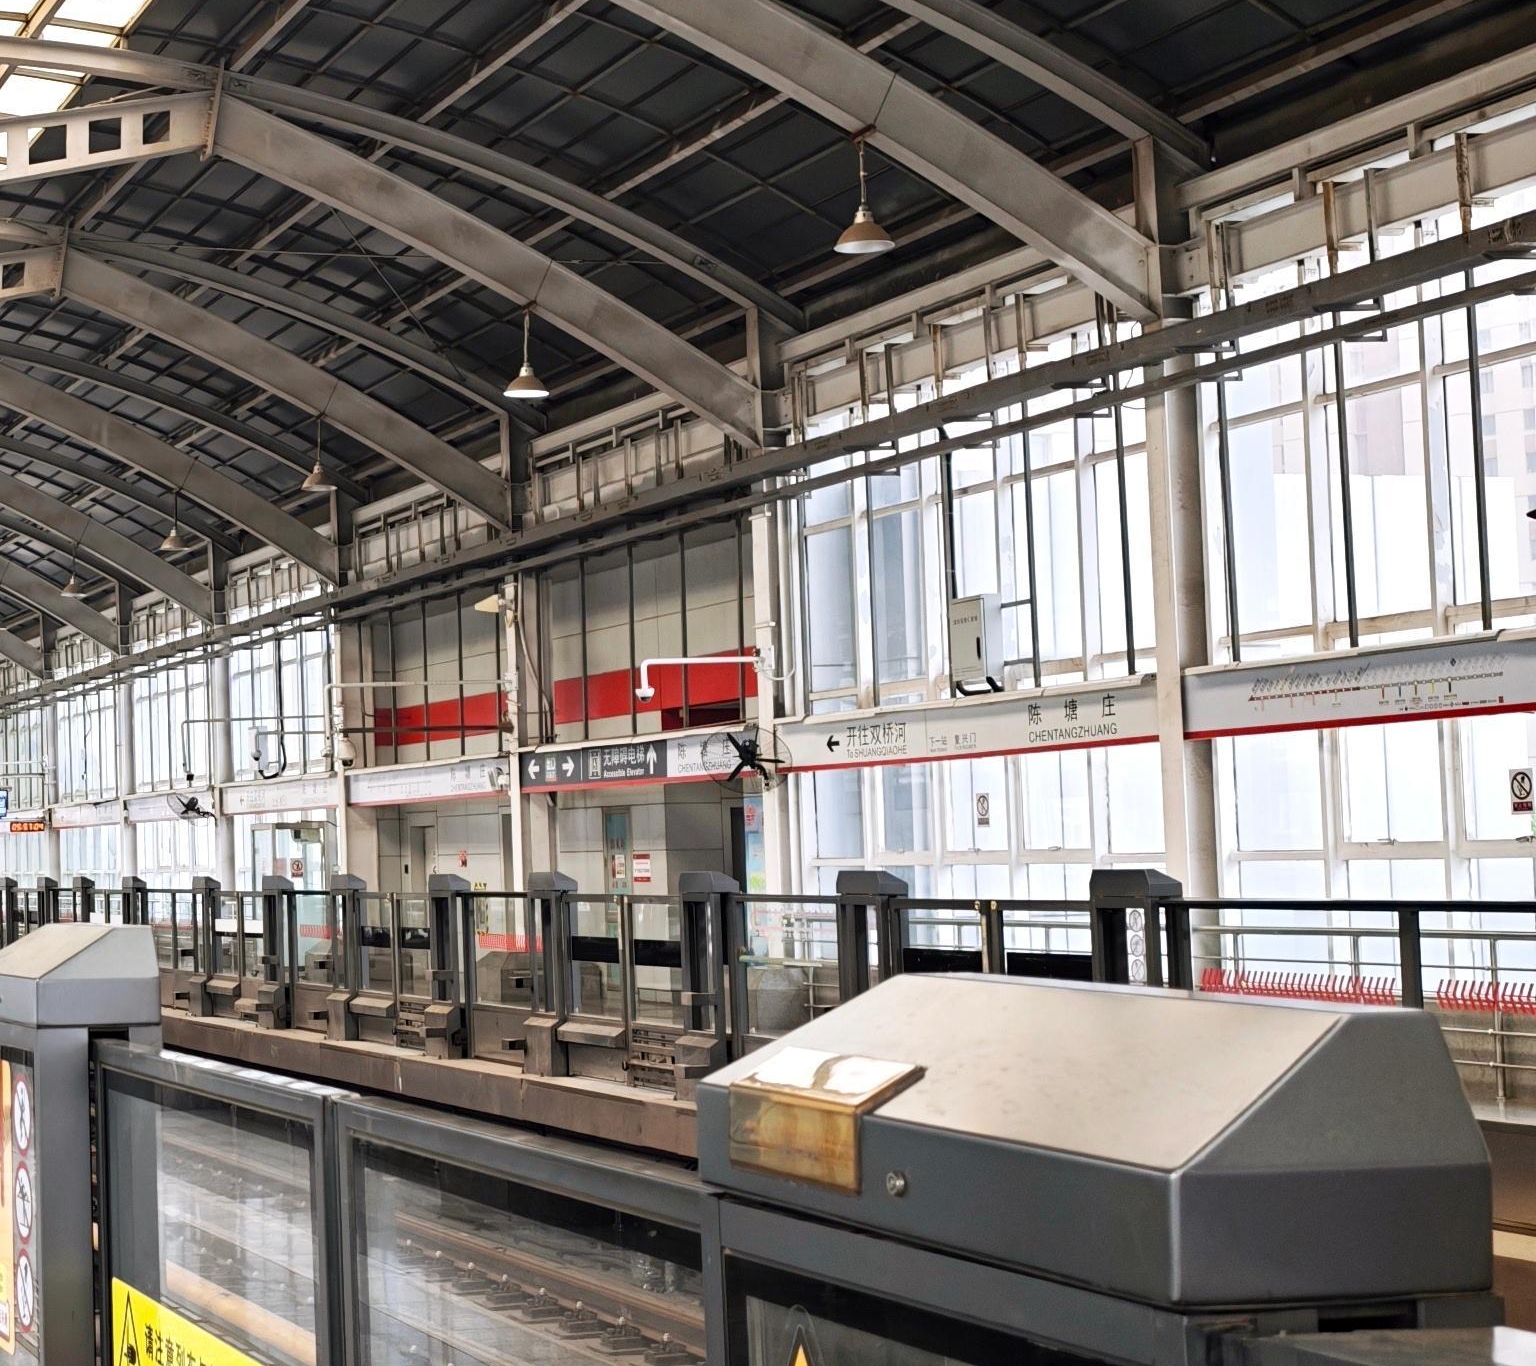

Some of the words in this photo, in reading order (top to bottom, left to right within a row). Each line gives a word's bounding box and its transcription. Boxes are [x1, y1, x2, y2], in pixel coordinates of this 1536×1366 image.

[1027, 692, 1116, 727] 陈塘庄
[846, 721, 907, 748] 开往双桥河
[1028, 723, 1118, 743] CHENTANGZHUANG
[603, 744, 645, 767] 无障碍电梯
[854, 745, 908, 758] SHUANGQIAOHE
